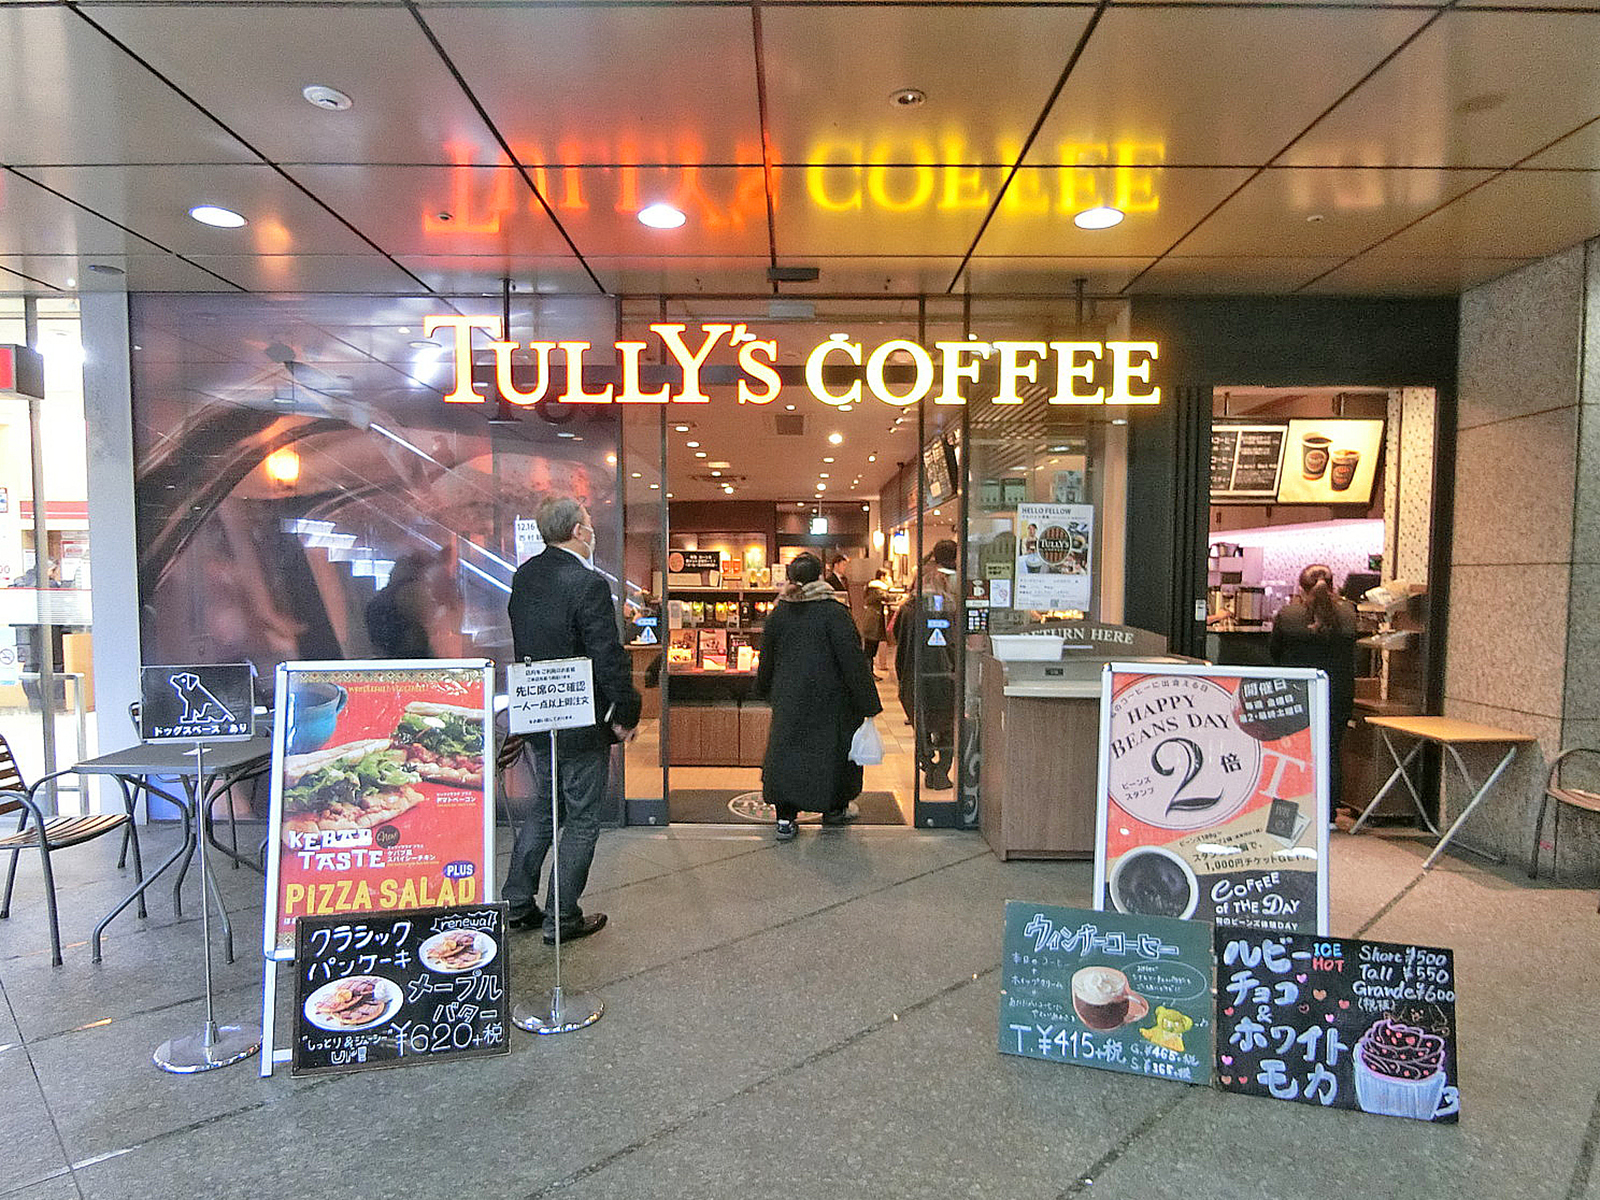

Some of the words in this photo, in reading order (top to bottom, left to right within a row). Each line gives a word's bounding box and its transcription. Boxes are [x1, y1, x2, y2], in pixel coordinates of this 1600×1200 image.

[423, 315, 782, 405] TULLY'S
[805, 339, 1162, 405] COFFEE
[1021, 628, 1085, 640] TURN
[1091, 628, 1135, 645] HERE
[516, 680, 586, 697] 先に席のご確認
[1127, 694, 1195, 725] HAPPY
[153, 725, 221, 737] ドッグスペース
[228, 723, 248, 734] あり
[1109, 717, 1180, 760] BEANS
[1187, 713, 1231, 731] DAY
[1220, 752, 1243, 774] 倍
[1121, 776, 1152, 791] ビーンズ
[1125, 786, 1155, 801] スタンプ
[288, 828, 373, 851] KEBAB
[297, 850, 386, 872] TASTE
[446, 864, 474, 877] PLUS
[285, 880, 372, 914] PIZZA
[380, 876, 476, 909] SALAD
[1211, 872, 1281, 902] COFFEE
[1215, 902, 1229, 915] of
[1234, 901, 1259, 915] THE
[1262, 893, 1300, 916] DAY
[440, 914, 493, 928] renewal
[310, 921, 411, 957] クラシック
[1024, 914, 1180, 959] ウィンナーコーヒー
[1223, 937, 1312, 974] ルビー
[1312, 942, 1343, 958] ICE
[307, 949, 412, 981] パンケーキ
[1312, 957, 1345, 973] HOT
[1358, 963, 1394, 982] Tall
[408, 969, 503, 1003] メープル
[1226, 970, 1300, 1006] チョコ
[1352, 980, 1416, 1000] Grande
[432, 1001, 498, 1024] バター
[1256, 1004, 1273, 1024] &
[1229, 1016, 1350, 1067] ホワイト
[1257, 1059, 1338, 1106] モカ
